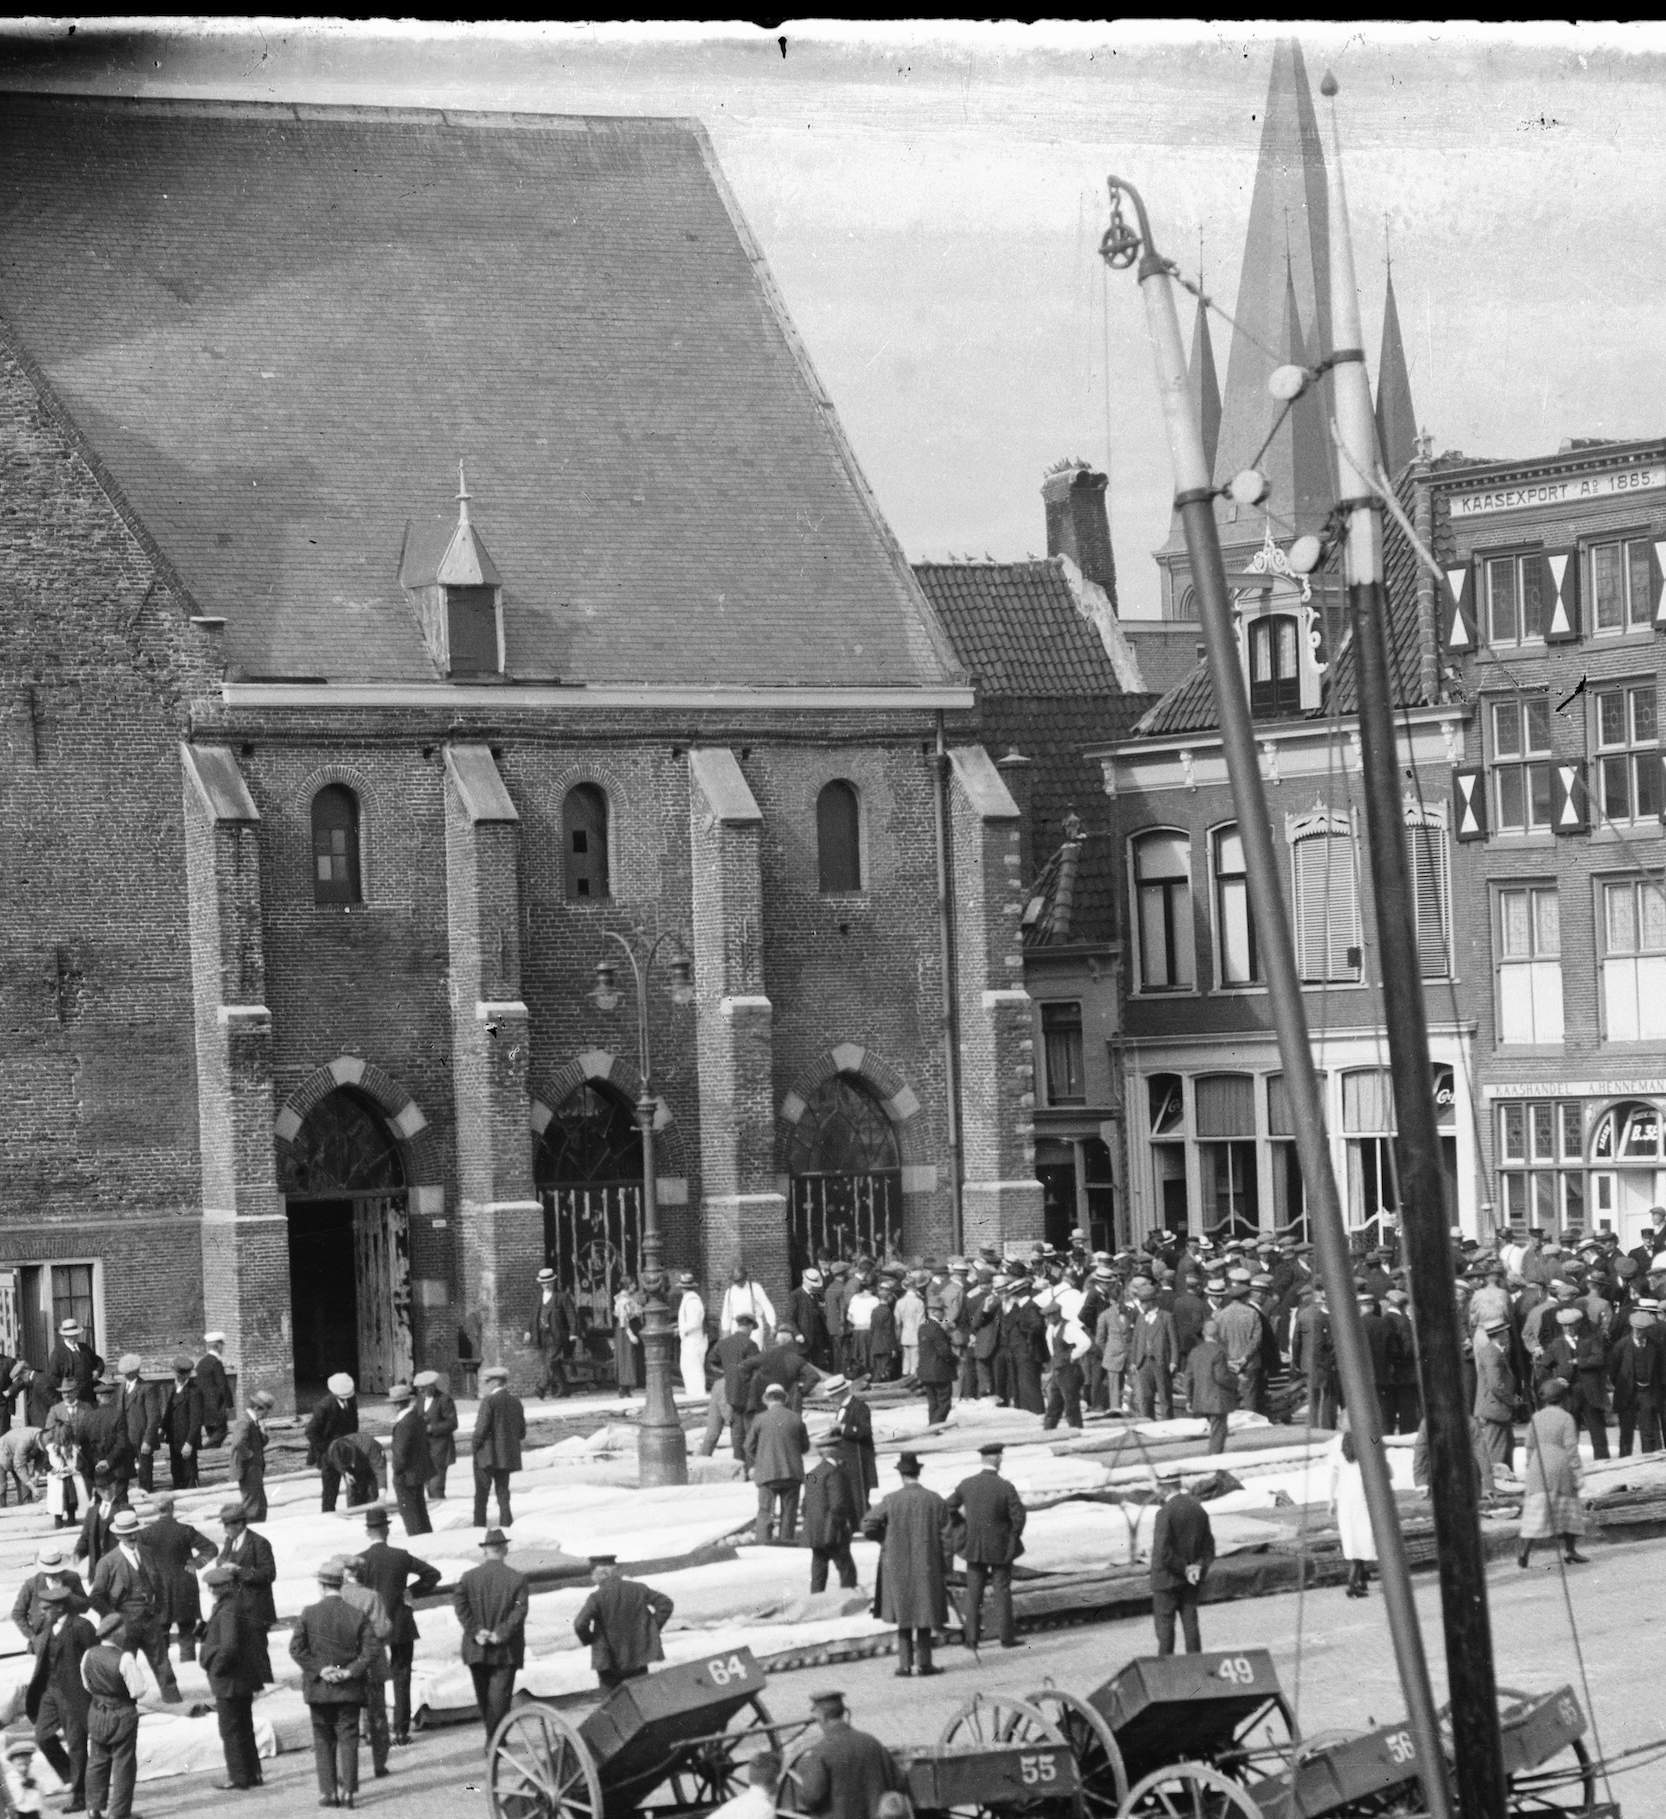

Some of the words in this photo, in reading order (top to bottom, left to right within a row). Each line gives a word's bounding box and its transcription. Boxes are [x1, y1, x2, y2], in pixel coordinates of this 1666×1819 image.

[1461, 484, 1569, 513] KAASEXPORT
[1495, 1083, 1573, 1097] KAASHANDEL
[707, 1654, 748, 1686] 64
[1218, 1657, 1255, 1684] 49
[1386, 1731, 1416, 1763] 56
[1020, 1753, 1057, 1784] 55
